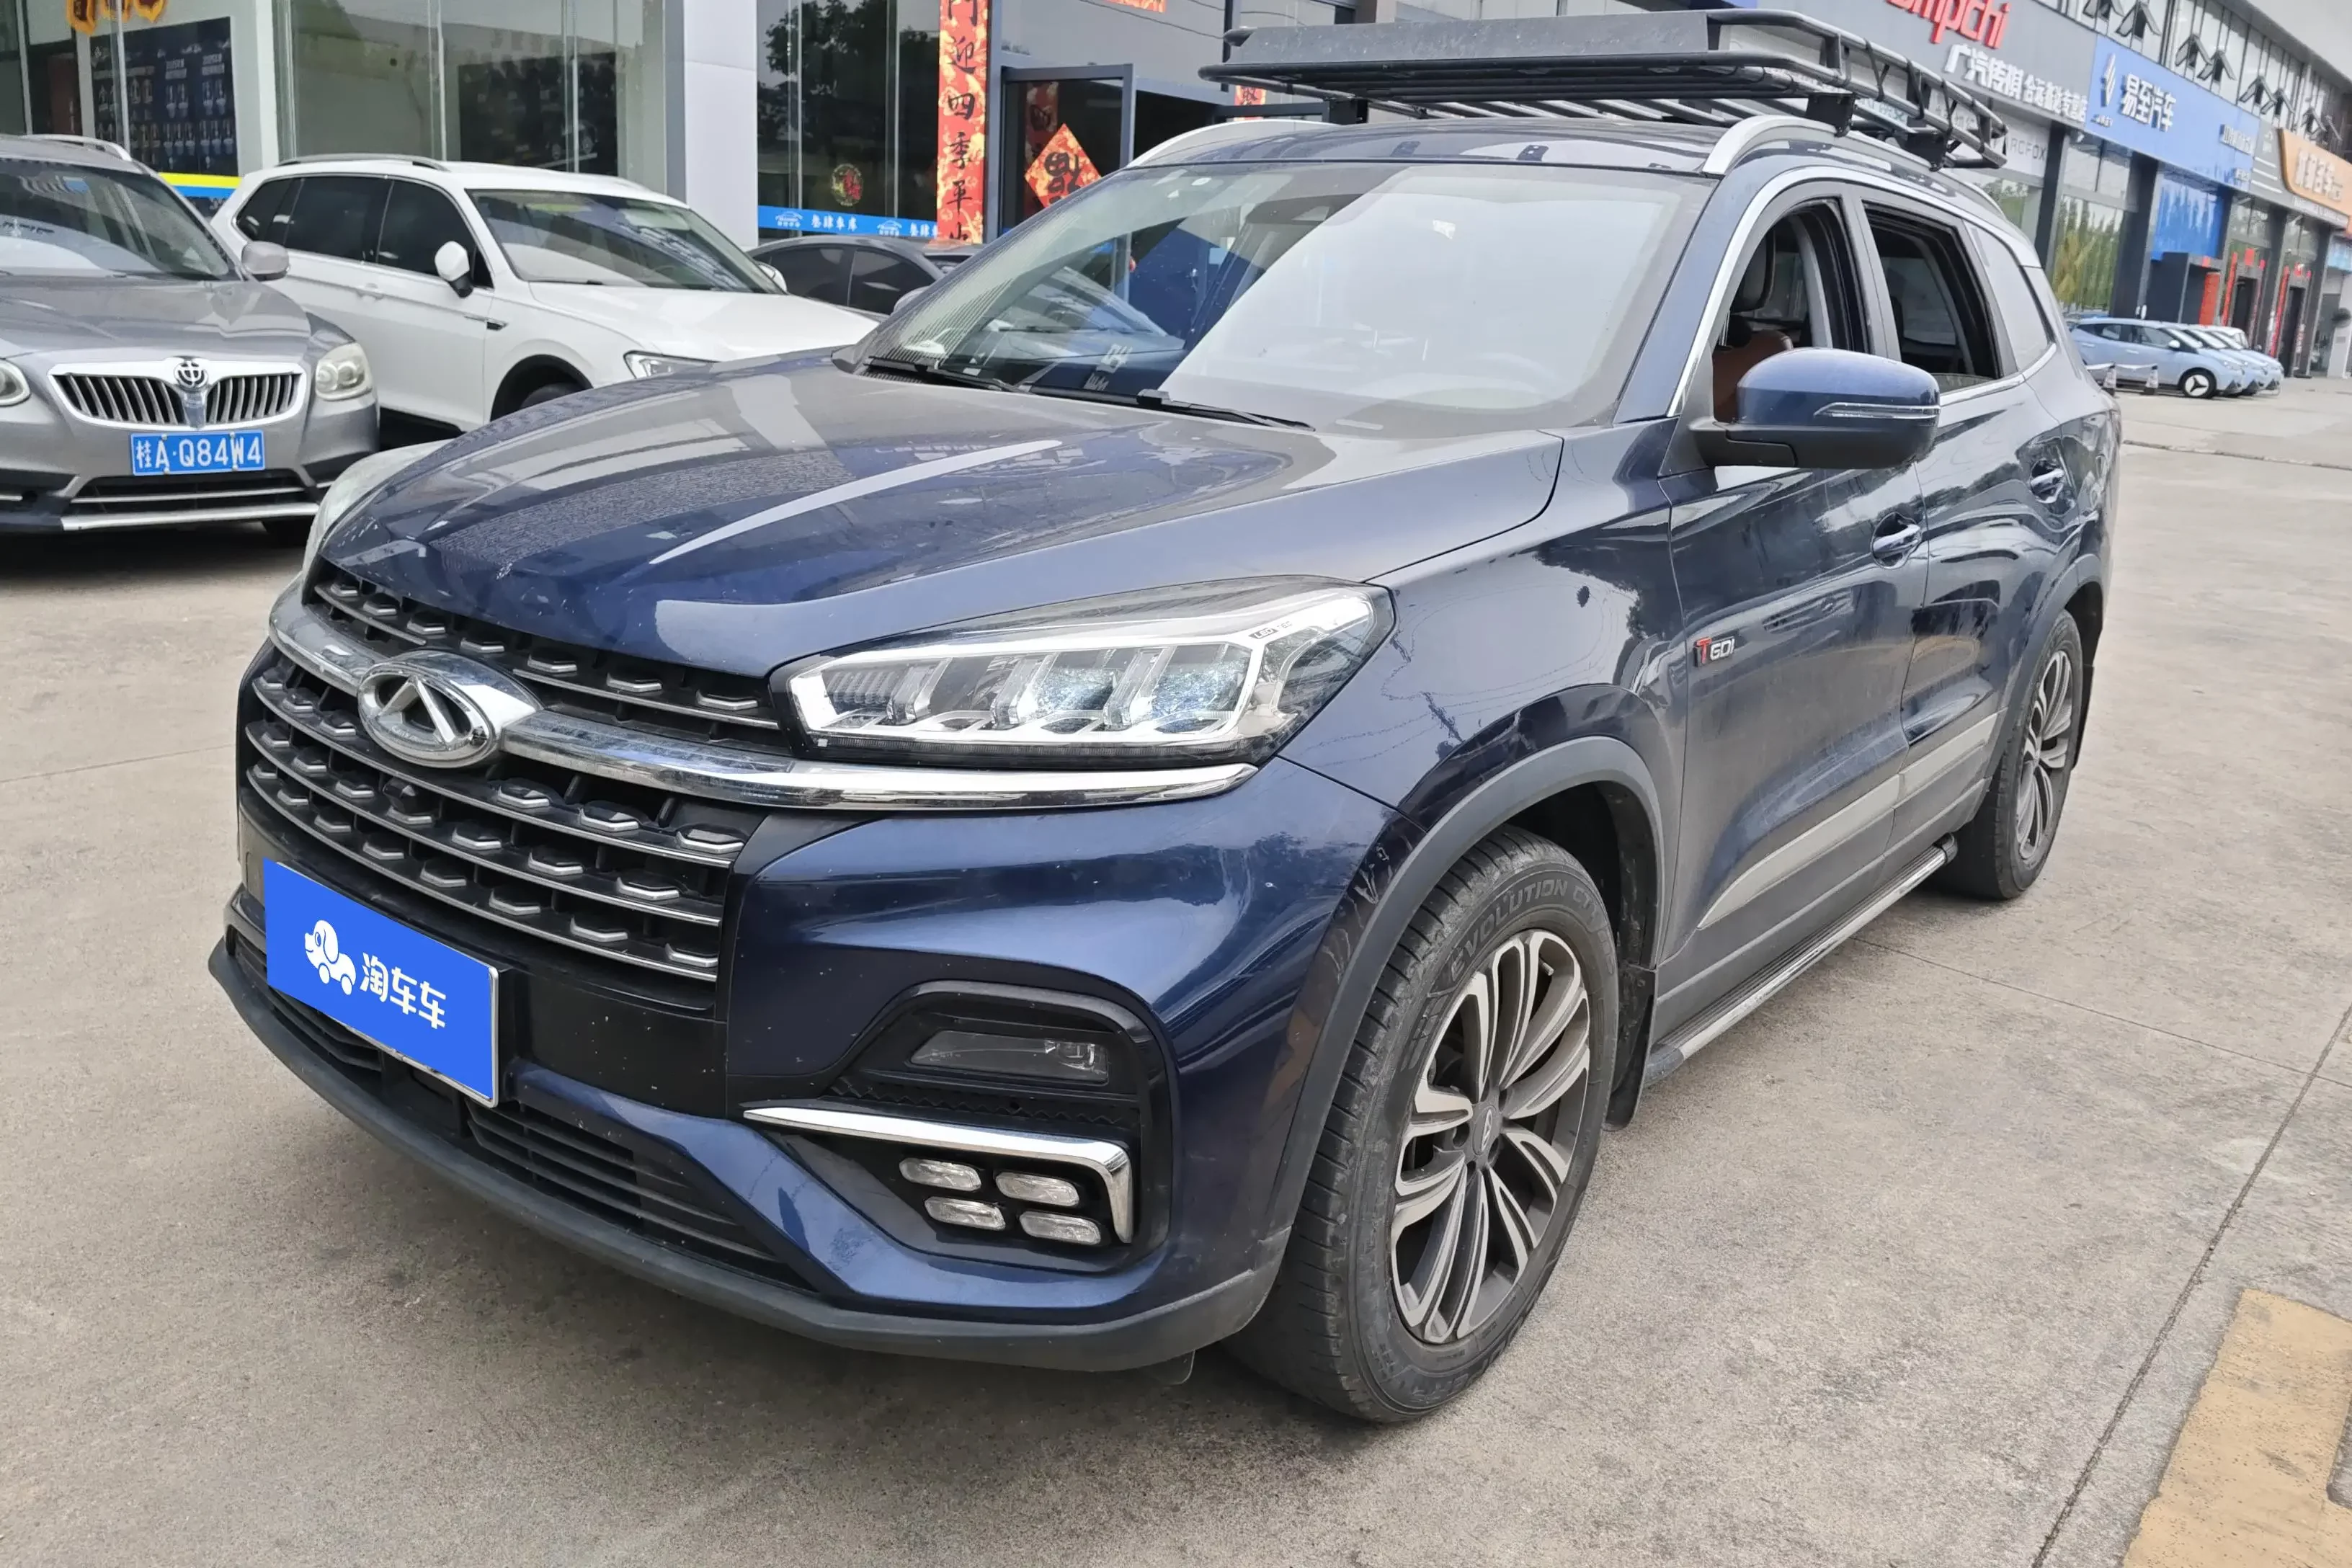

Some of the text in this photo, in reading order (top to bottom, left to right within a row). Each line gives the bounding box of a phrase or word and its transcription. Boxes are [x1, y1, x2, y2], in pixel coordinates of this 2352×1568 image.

[2121, 73, 2176, 133] 易至汽车
[1451, 878, 1568, 982] EVOLUTION
